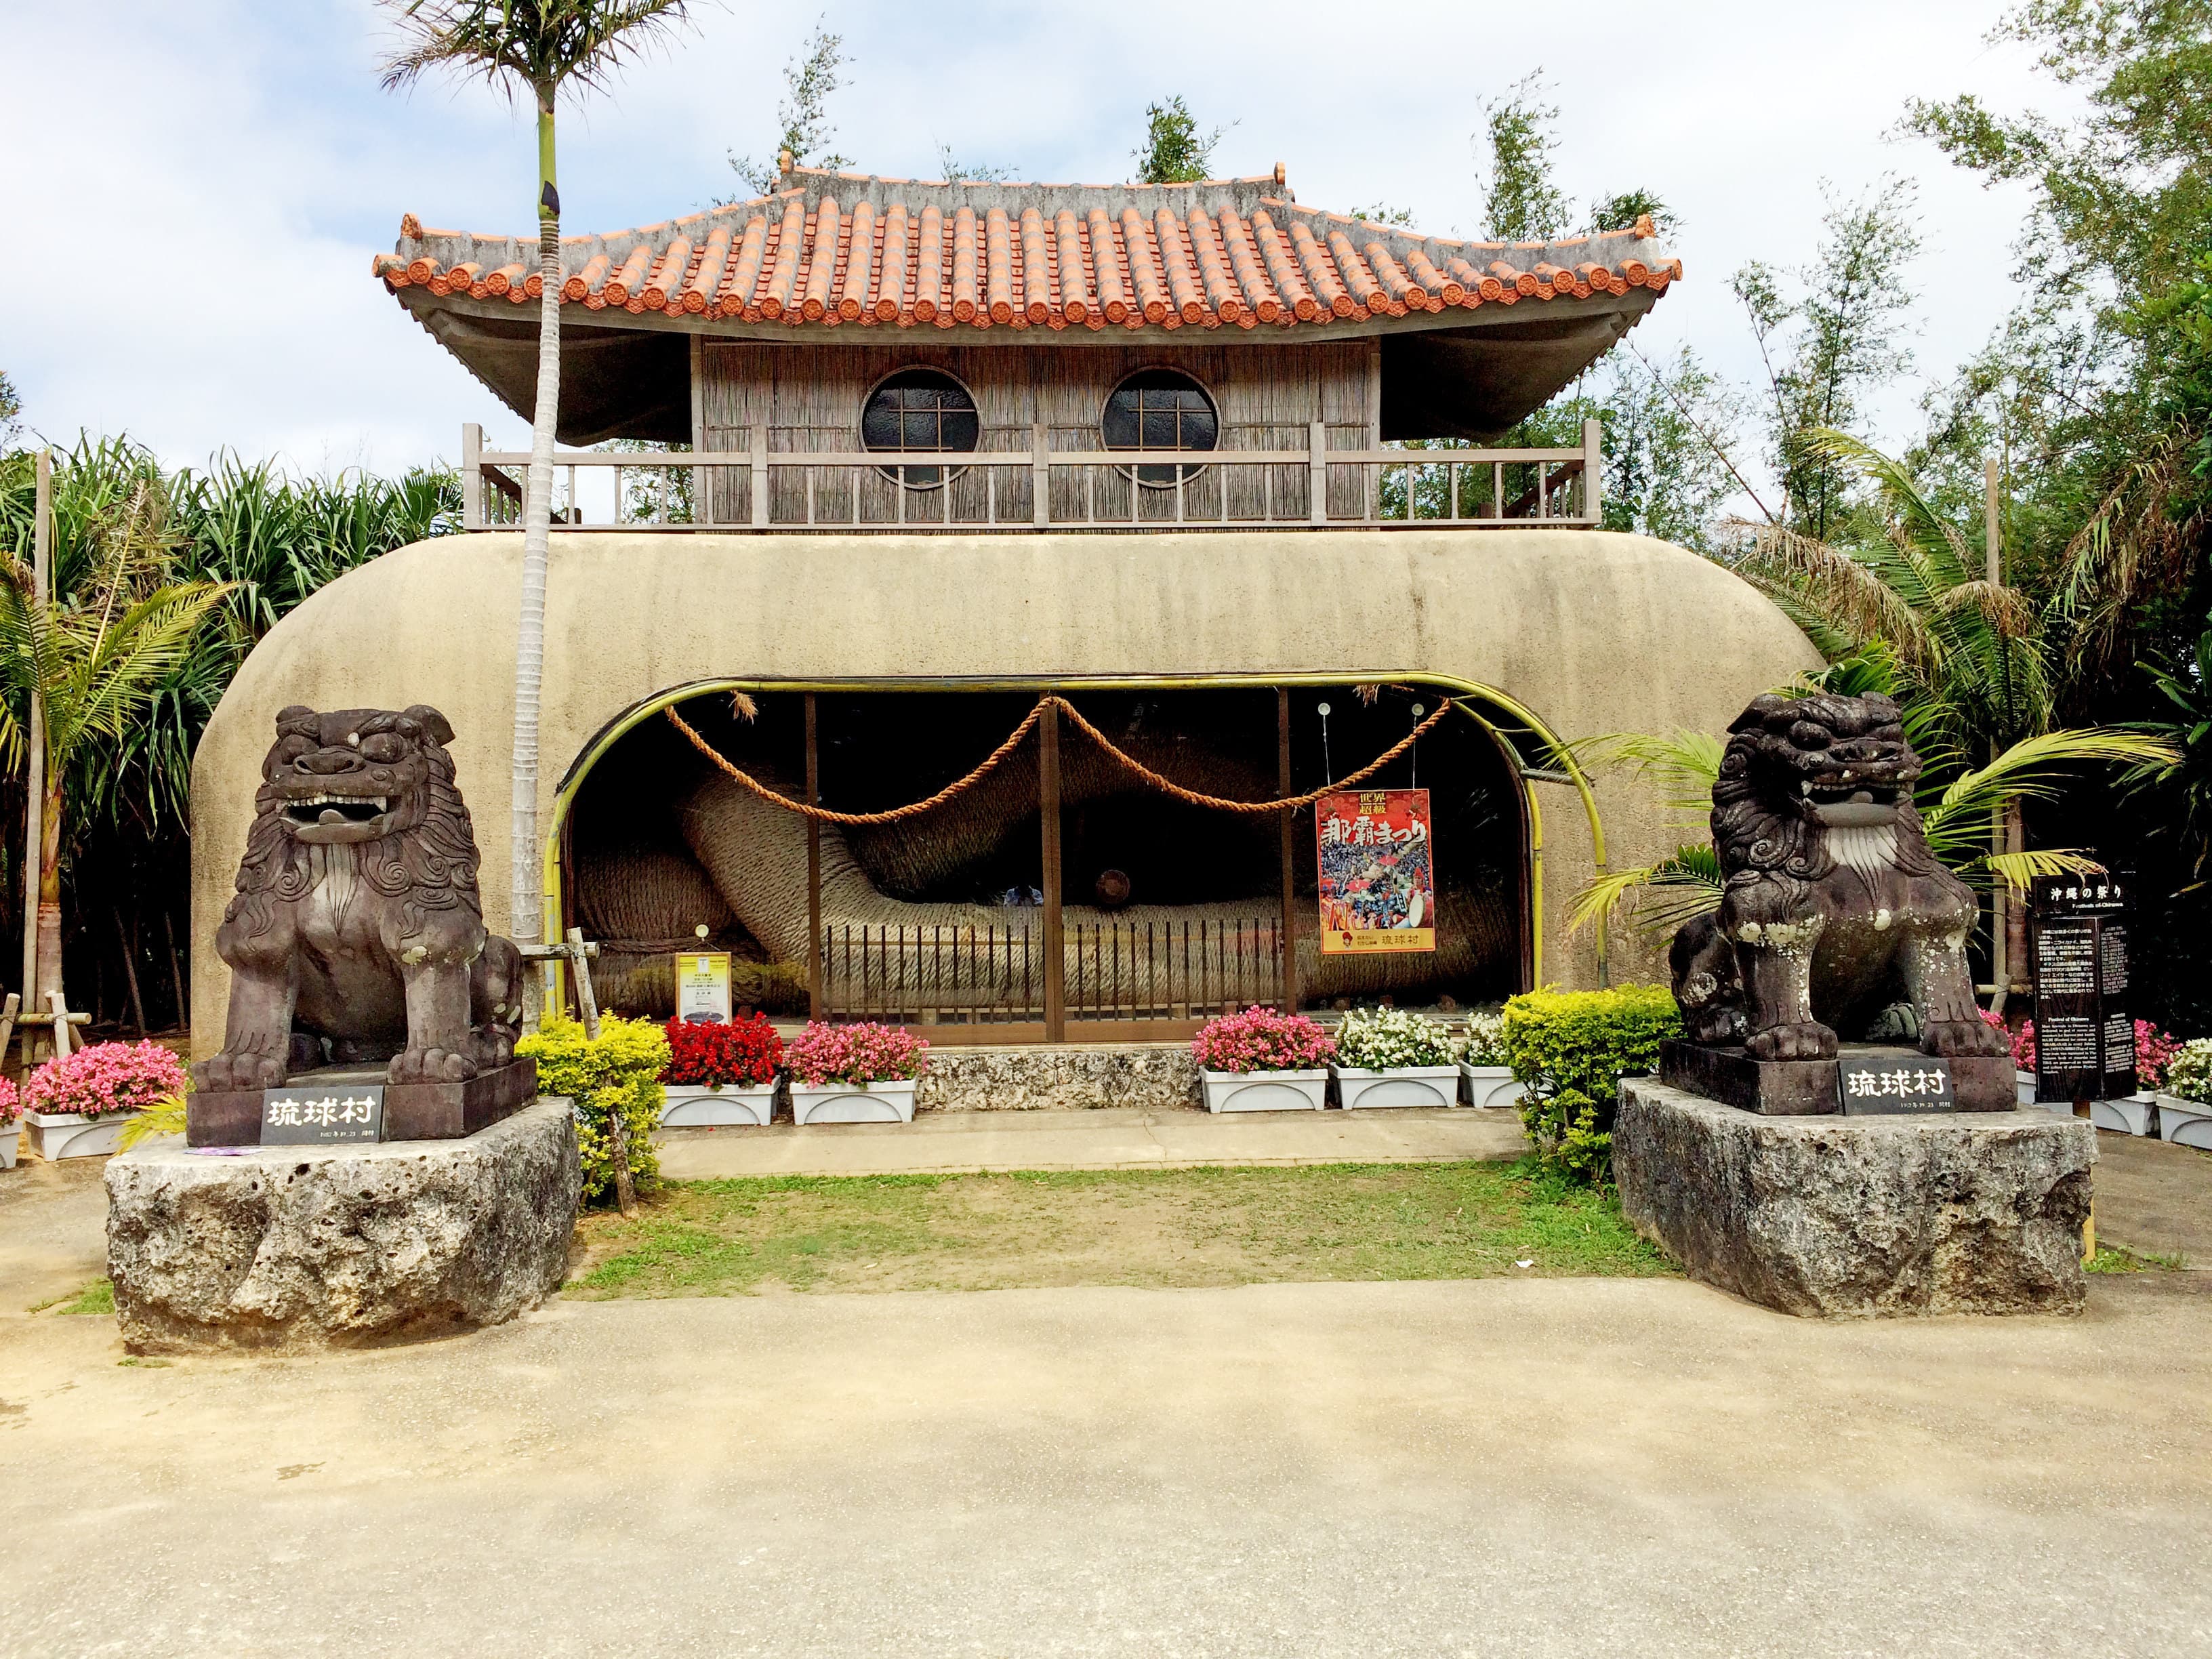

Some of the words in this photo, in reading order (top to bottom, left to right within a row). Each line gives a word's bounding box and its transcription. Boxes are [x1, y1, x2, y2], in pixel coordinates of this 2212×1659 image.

[1359, 792, 1386, 803] 世界
[2050, 885, 2121, 901] 沖縄の祭り
[1382, 934, 1419, 945] 琉球村
[1847, 1068, 1946, 1099] 琉球村
[267, 1095, 376, 1127] 琉球村
